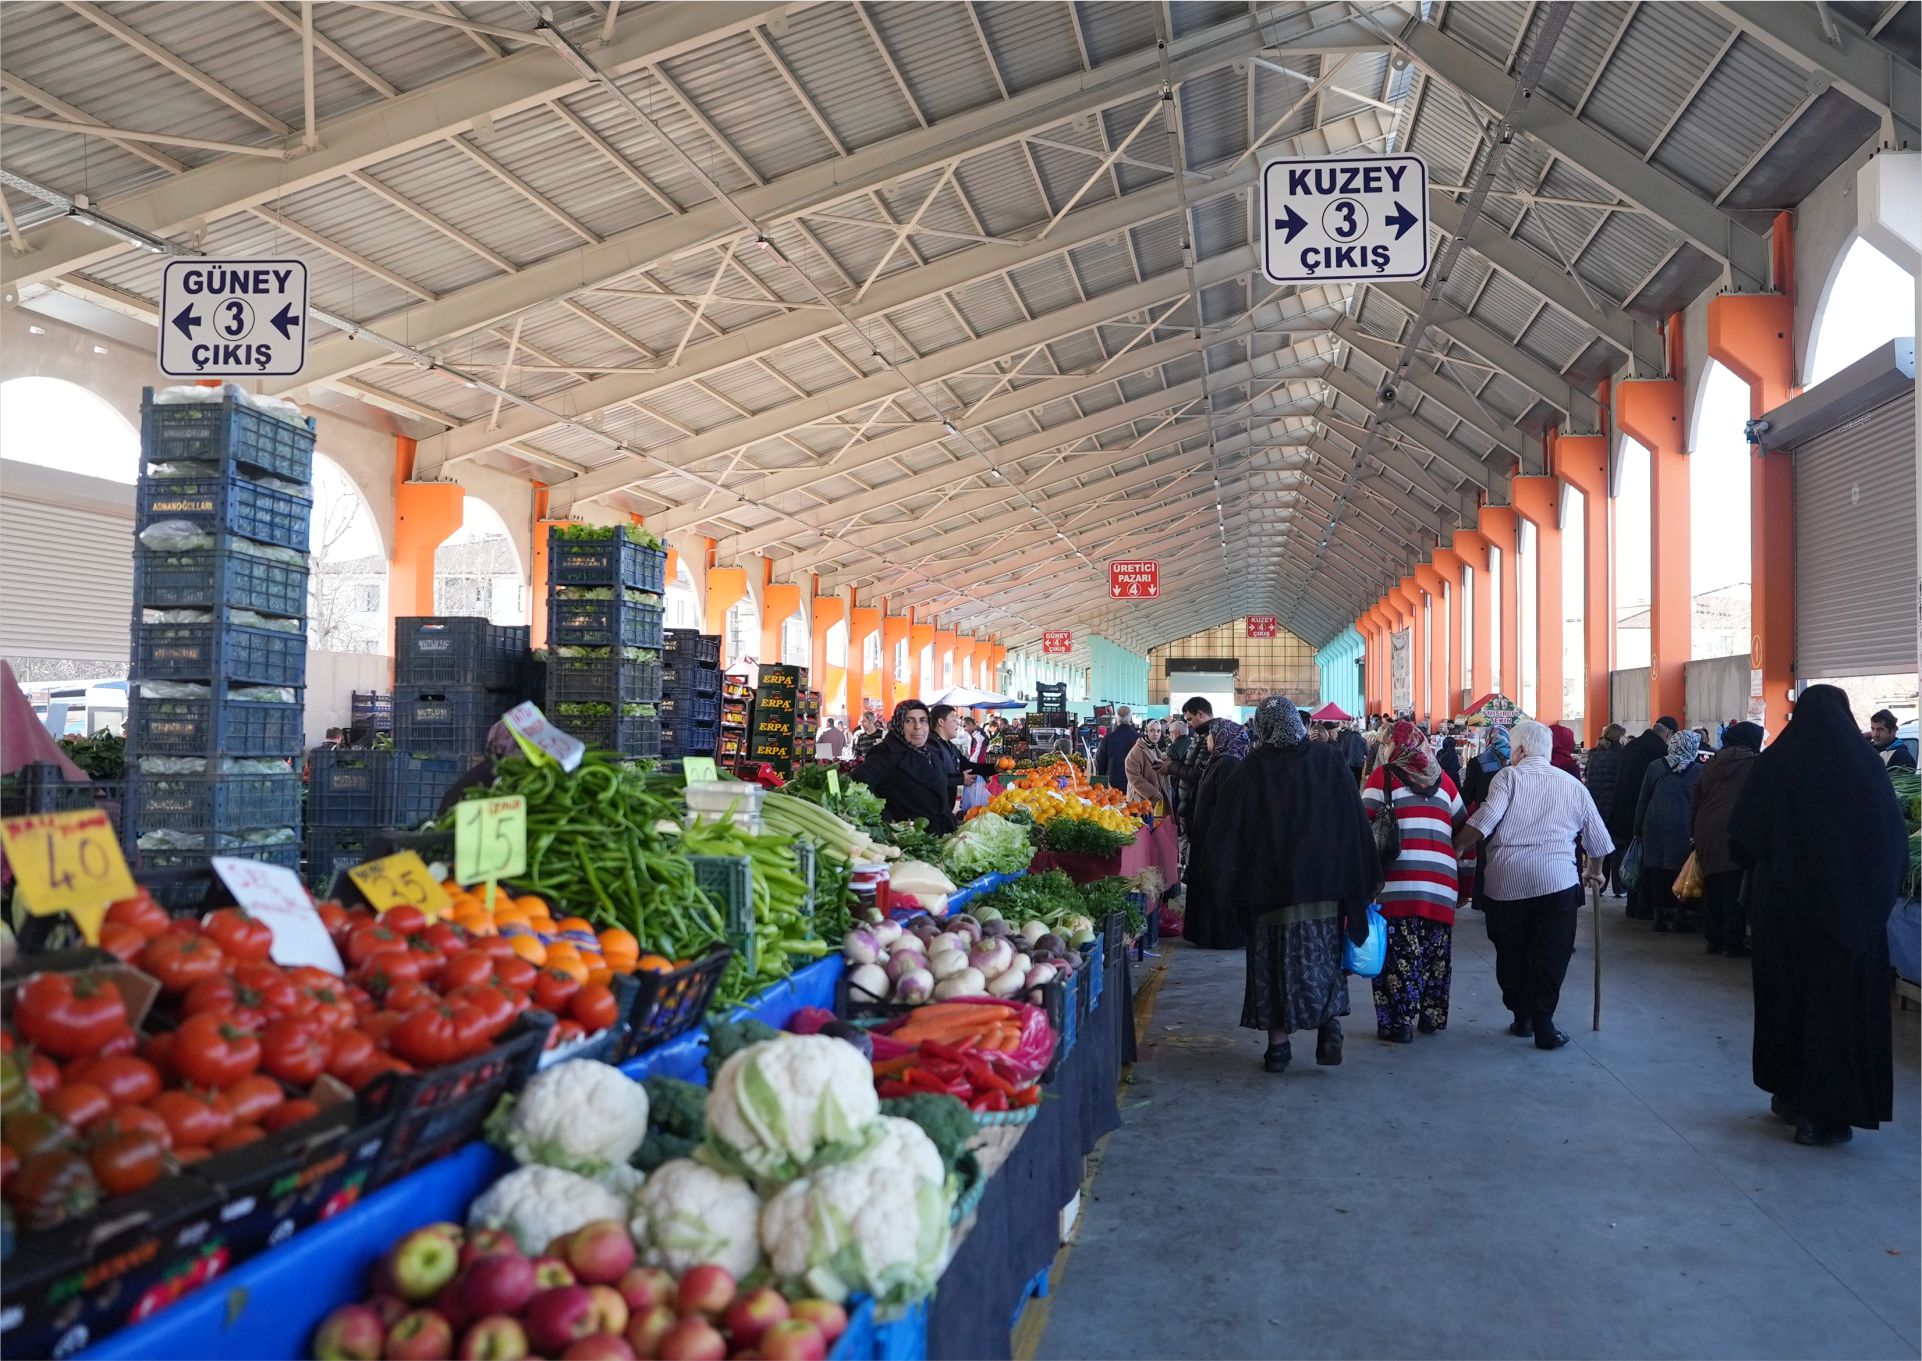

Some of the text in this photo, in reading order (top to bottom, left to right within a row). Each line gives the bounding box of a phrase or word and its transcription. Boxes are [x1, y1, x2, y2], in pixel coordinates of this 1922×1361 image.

[1289, 166, 1407, 196] KUZEY
[1335, 201, 1357, 238] 3
[1300, 245, 1391, 275] ÇIKIŞ
[183, 265, 293, 294] GÜNEY
[224, 301, 244, 336] 3
[191, 344, 272, 371] ÇIKIŞ
[1113, 562, 1155, 572] ÜRETİCİ
[1118, 574, 1151, 582] PAZARI
[1130, 583, 1138, 595] 4
[763, 675, 793, 685] ERPA
[761, 698, 791, 708] ERPA
[759, 722, 789, 732] ERPA
[757, 746, 787, 756] ERPA
[467, 806, 514, 880] 15
[47, 832, 111, 891] 40
